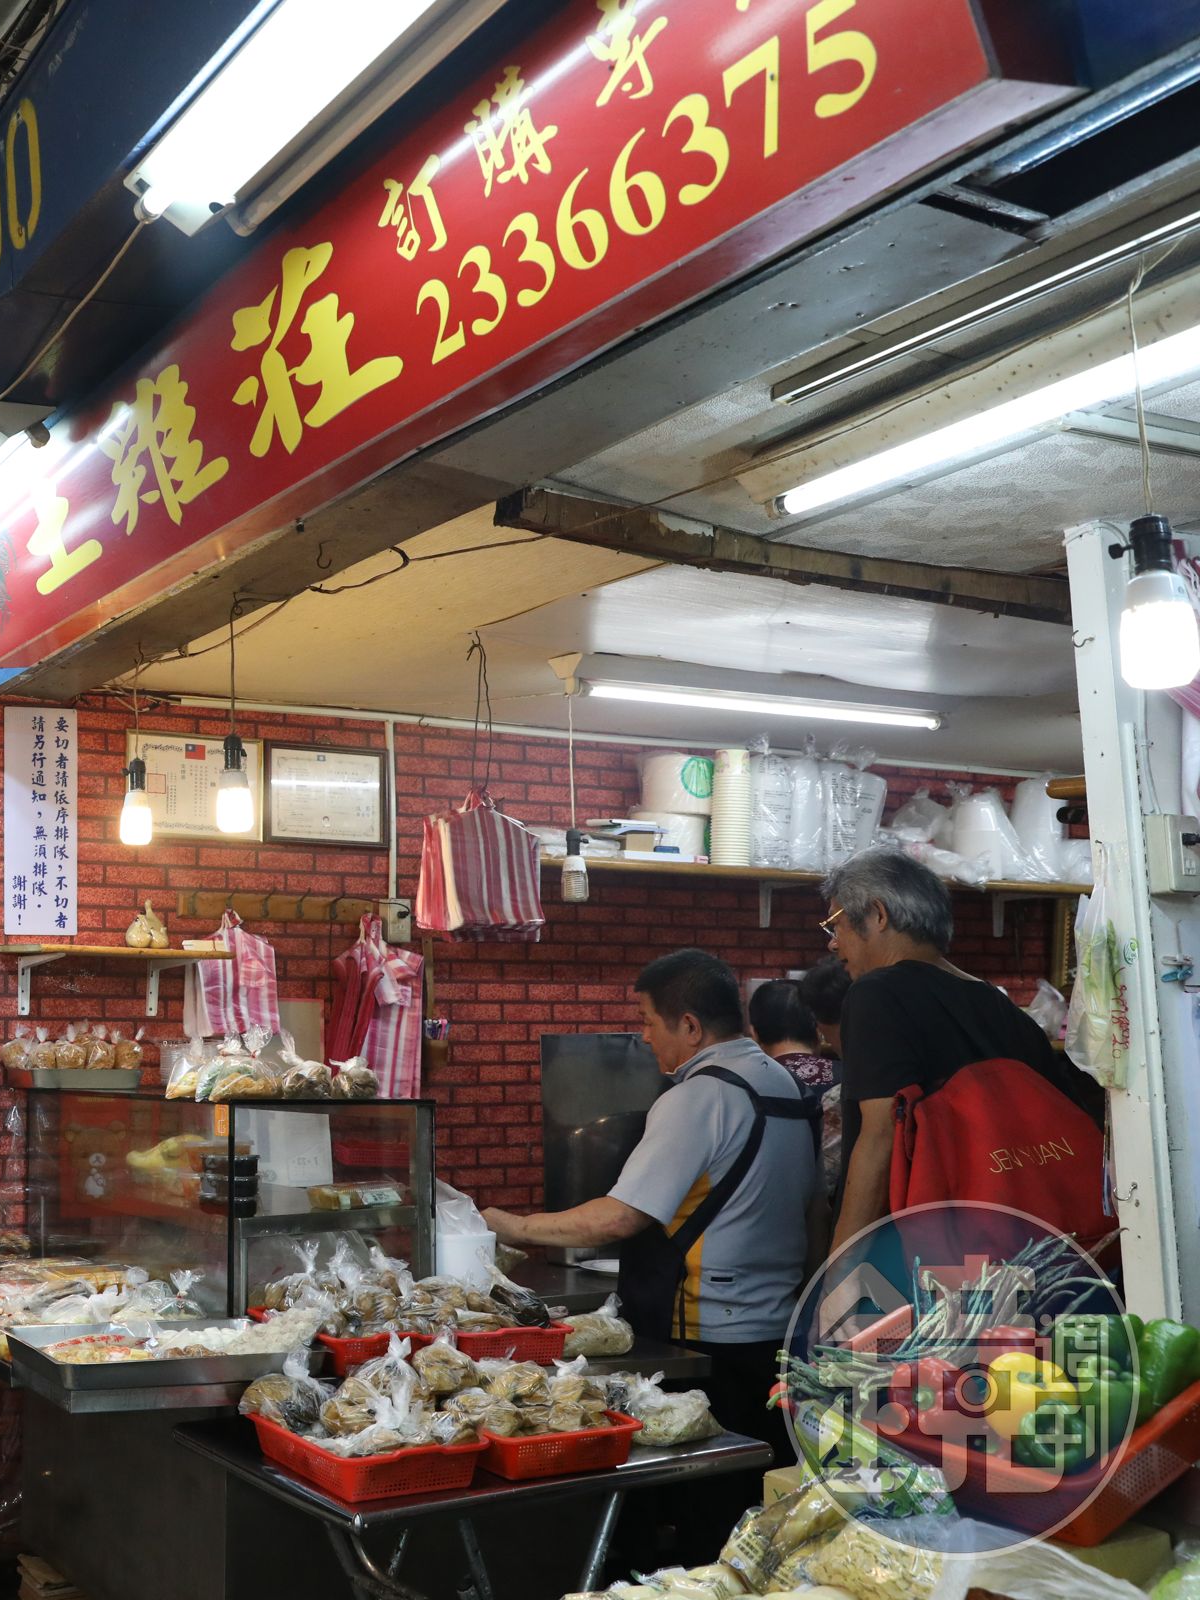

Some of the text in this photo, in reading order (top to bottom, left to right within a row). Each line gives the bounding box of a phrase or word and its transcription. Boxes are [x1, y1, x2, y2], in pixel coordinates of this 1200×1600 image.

[378, 0, 749, 261] 訂購專
[416, 0, 878, 366] 23366375
